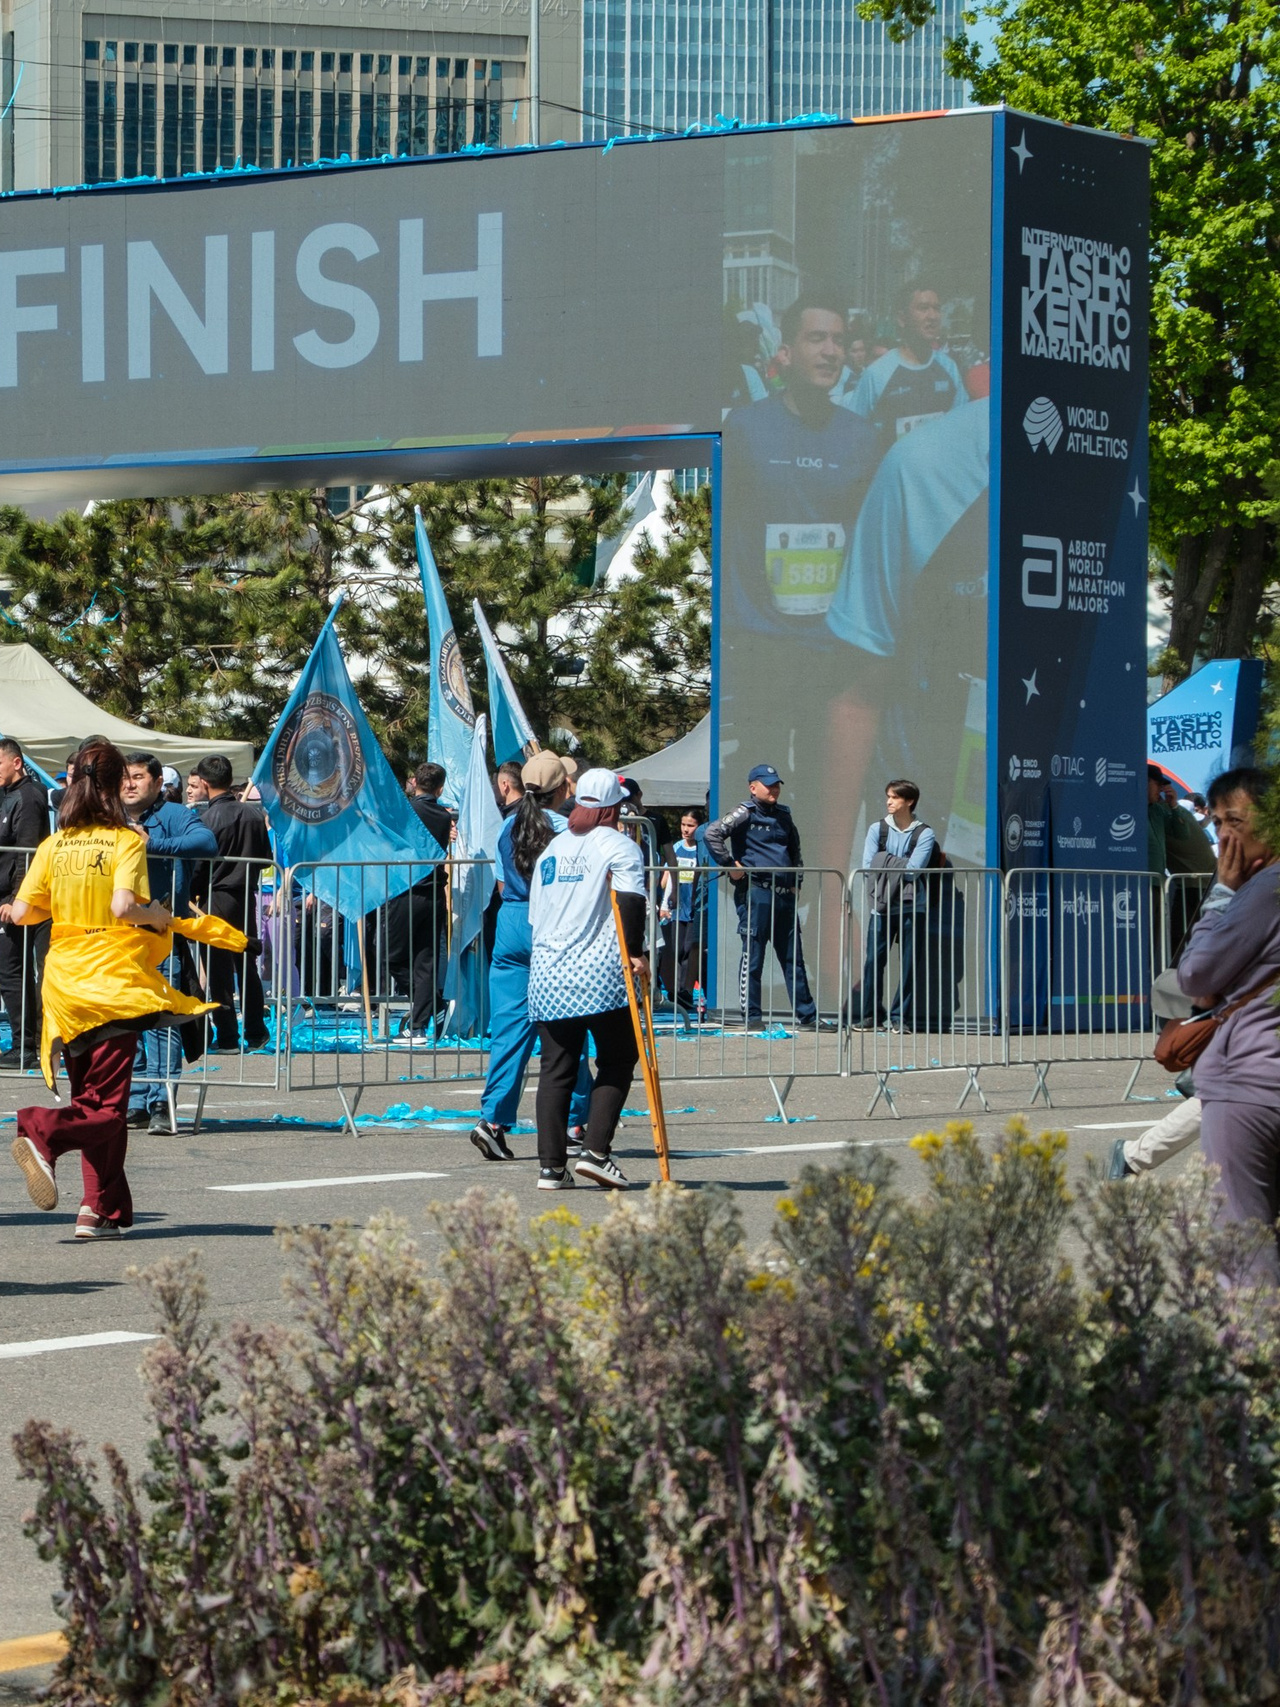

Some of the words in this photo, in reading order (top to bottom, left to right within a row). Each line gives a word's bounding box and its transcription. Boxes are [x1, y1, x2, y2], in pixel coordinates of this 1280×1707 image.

[1021, 226, 1115, 259] INTERNATIONAL
[1021, 242, 1117, 302] TASH
[1021, 286, 1117, 348] KENT
[1021, 333, 1116, 370] MARATHON
[1066, 405, 1109, 431] WORLD
[1066, 432, 1129, 460] ATHLETICS
[1067, 540, 1107, 558] ABBOTT
[1068, 557, 1104, 576] WORLD
[1067, 576, 1126, 597] MARATHON
[1067, 595, 1109, 613] MAJORS
[1150, 711, 1211, 723] INTERNATIONAL
[1150, 715, 1213, 735] TASH
[1151, 729, 1212, 747] KENT
[1152, 742, 1213, 754] MARATHON
[1022, 759, 1038, 768] ENCO
[1022, 769, 1042, 778] GROUP
[1062, 756, 1085, 776] TIAC
[64, 838, 115, 848] KAPITALBANK
[52, 848, 114, 878] RUN
